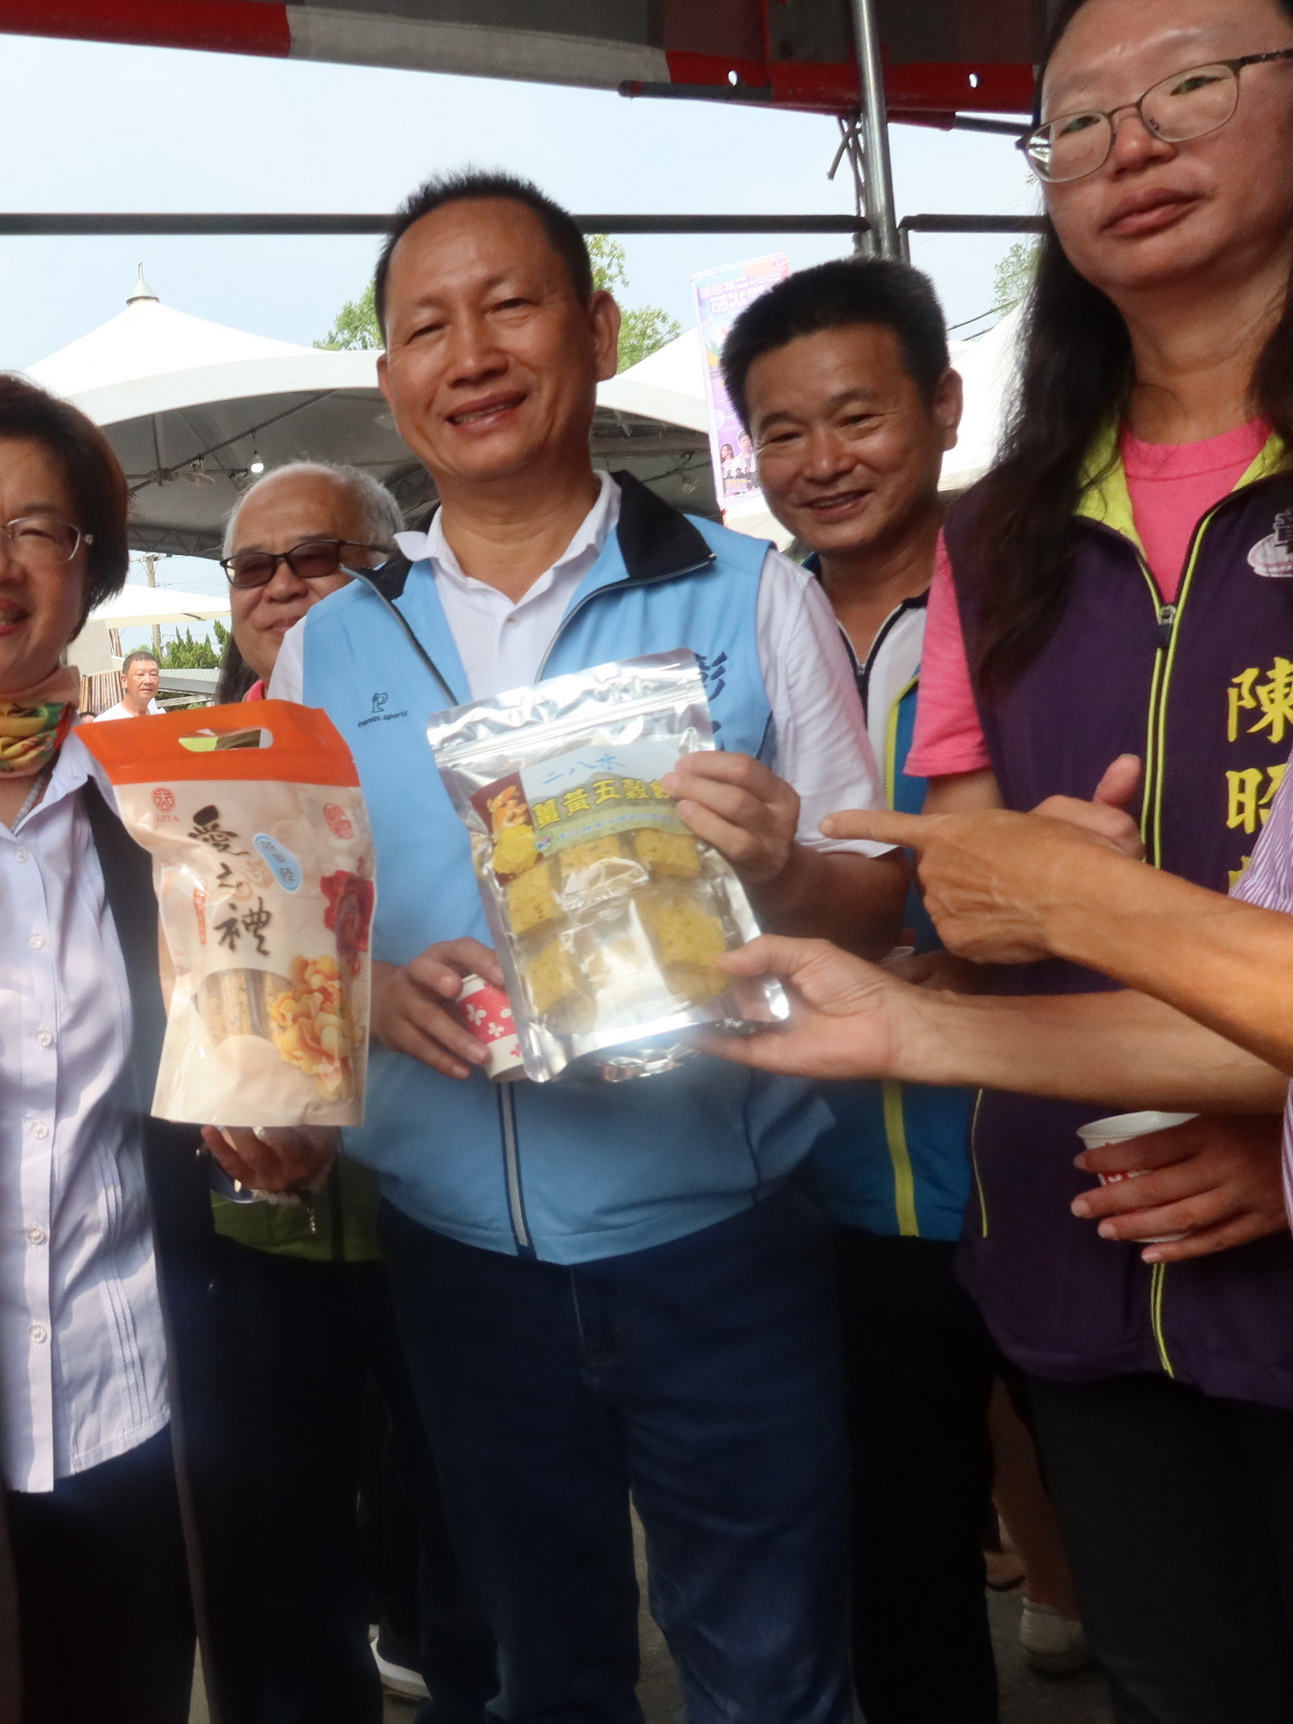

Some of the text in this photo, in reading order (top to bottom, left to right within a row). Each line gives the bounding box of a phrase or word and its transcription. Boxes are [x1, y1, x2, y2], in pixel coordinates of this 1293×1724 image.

[541, 753, 626, 784] 二八水
[1225, 656, 1293, 896] 陳昭
[157, 814, 180, 823] LITA
[188, 804, 275, 957] 愛之禮
